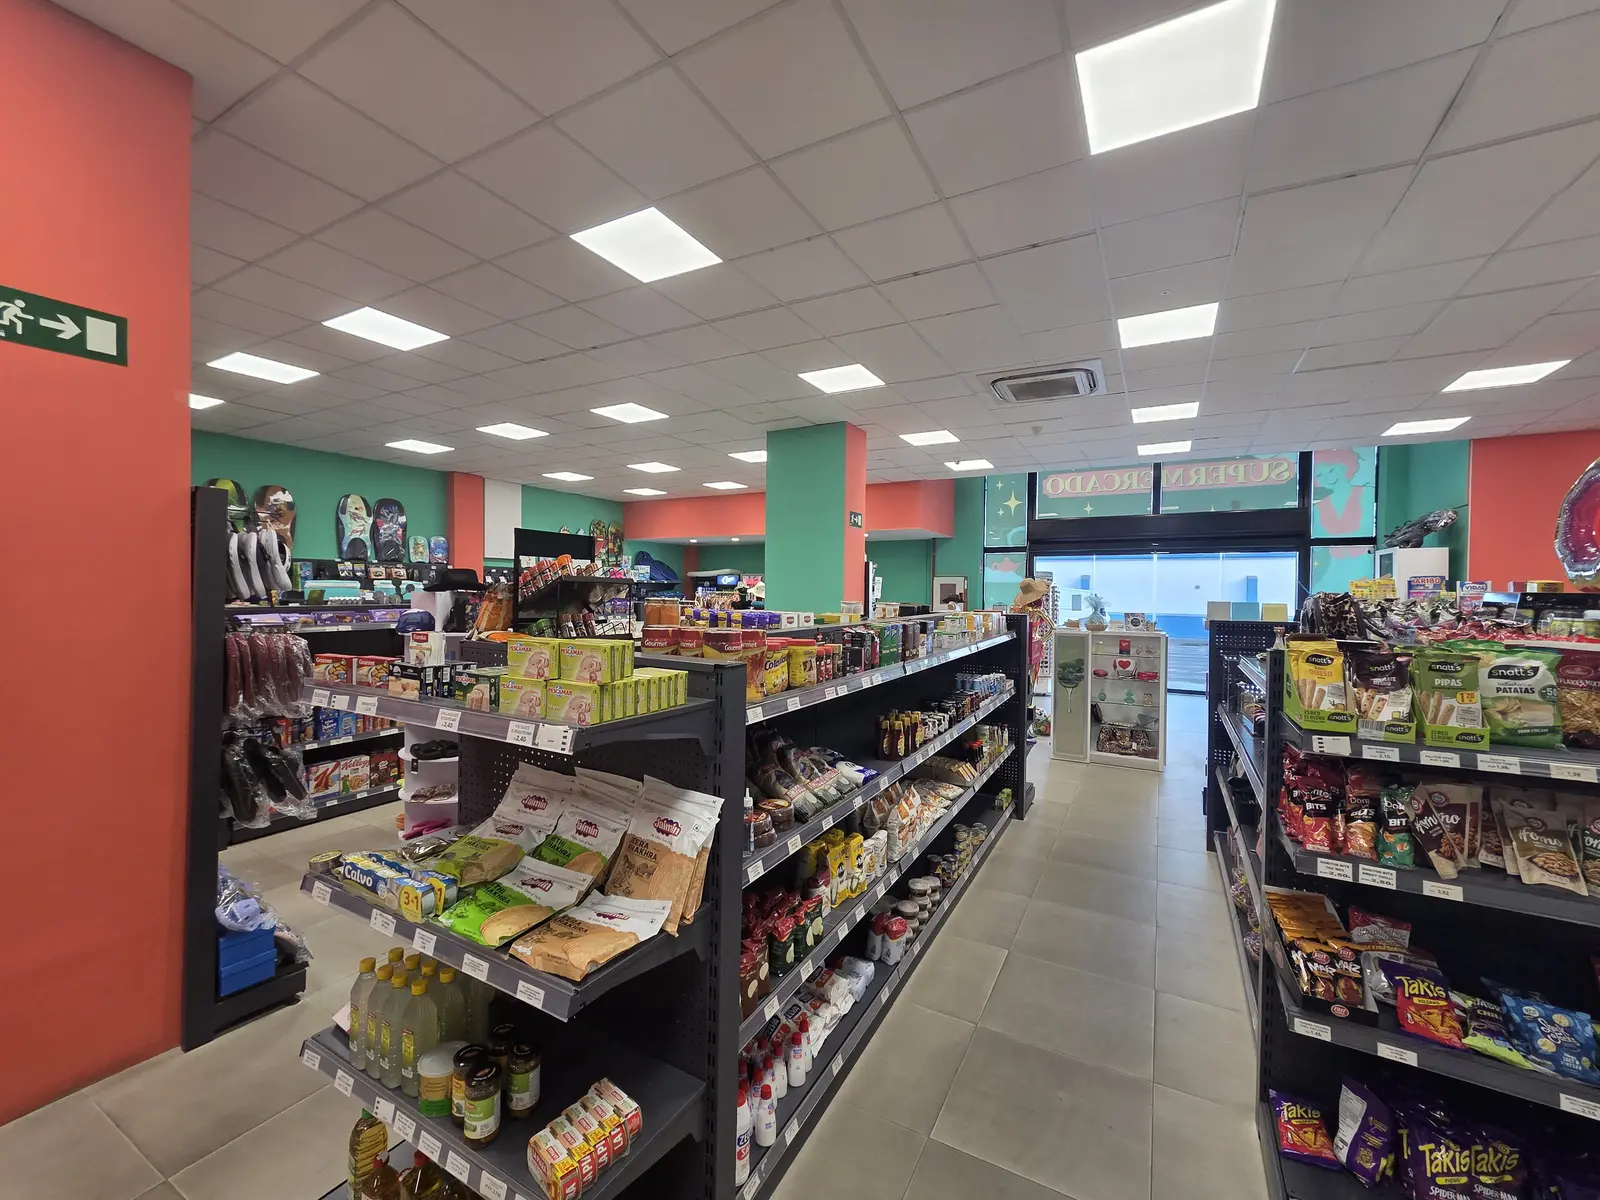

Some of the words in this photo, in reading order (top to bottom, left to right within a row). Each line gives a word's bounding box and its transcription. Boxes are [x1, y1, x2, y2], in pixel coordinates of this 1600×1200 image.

[1410, 577, 1441, 585] HARIBO
[644, 638, 667, 647] Gourmet
[509, 645, 532, 653] PESCAMAR
[560, 648, 584, 656] PESCAMAR
[1307, 655, 1332, 664] snatt's
[1369, 661, 1396, 672] snatt's
[1431, 663, 1462, 672] snatt's
[1491, 665, 1535, 677] snatt's
[1309, 669, 1333, 677] QUESO
[500, 683, 523, 691] PESCAMAR
[1434, 679, 1462, 687] PIPAS
[548, 687, 573, 696] PESCAMAR
[1329, 713, 1352, 721] snatt's
[1386, 724, 1409, 732] snatt's
[1458, 733, 1481, 741] snatt's
[521, 796, 548, 810] Jaimin
[1306, 802, 1327, 810] BITS
[1388, 818, 1407, 827] BIT
[653, 819, 681, 837] Jaimin
[344, 865, 373, 887] Calvo
[1395, 976, 1446, 999] Takis
[1281, 1102, 1321, 1122] Takis
[1418, 1143, 1470, 1177] Takis
[1471, 1145, 1519, 1177] Takis
